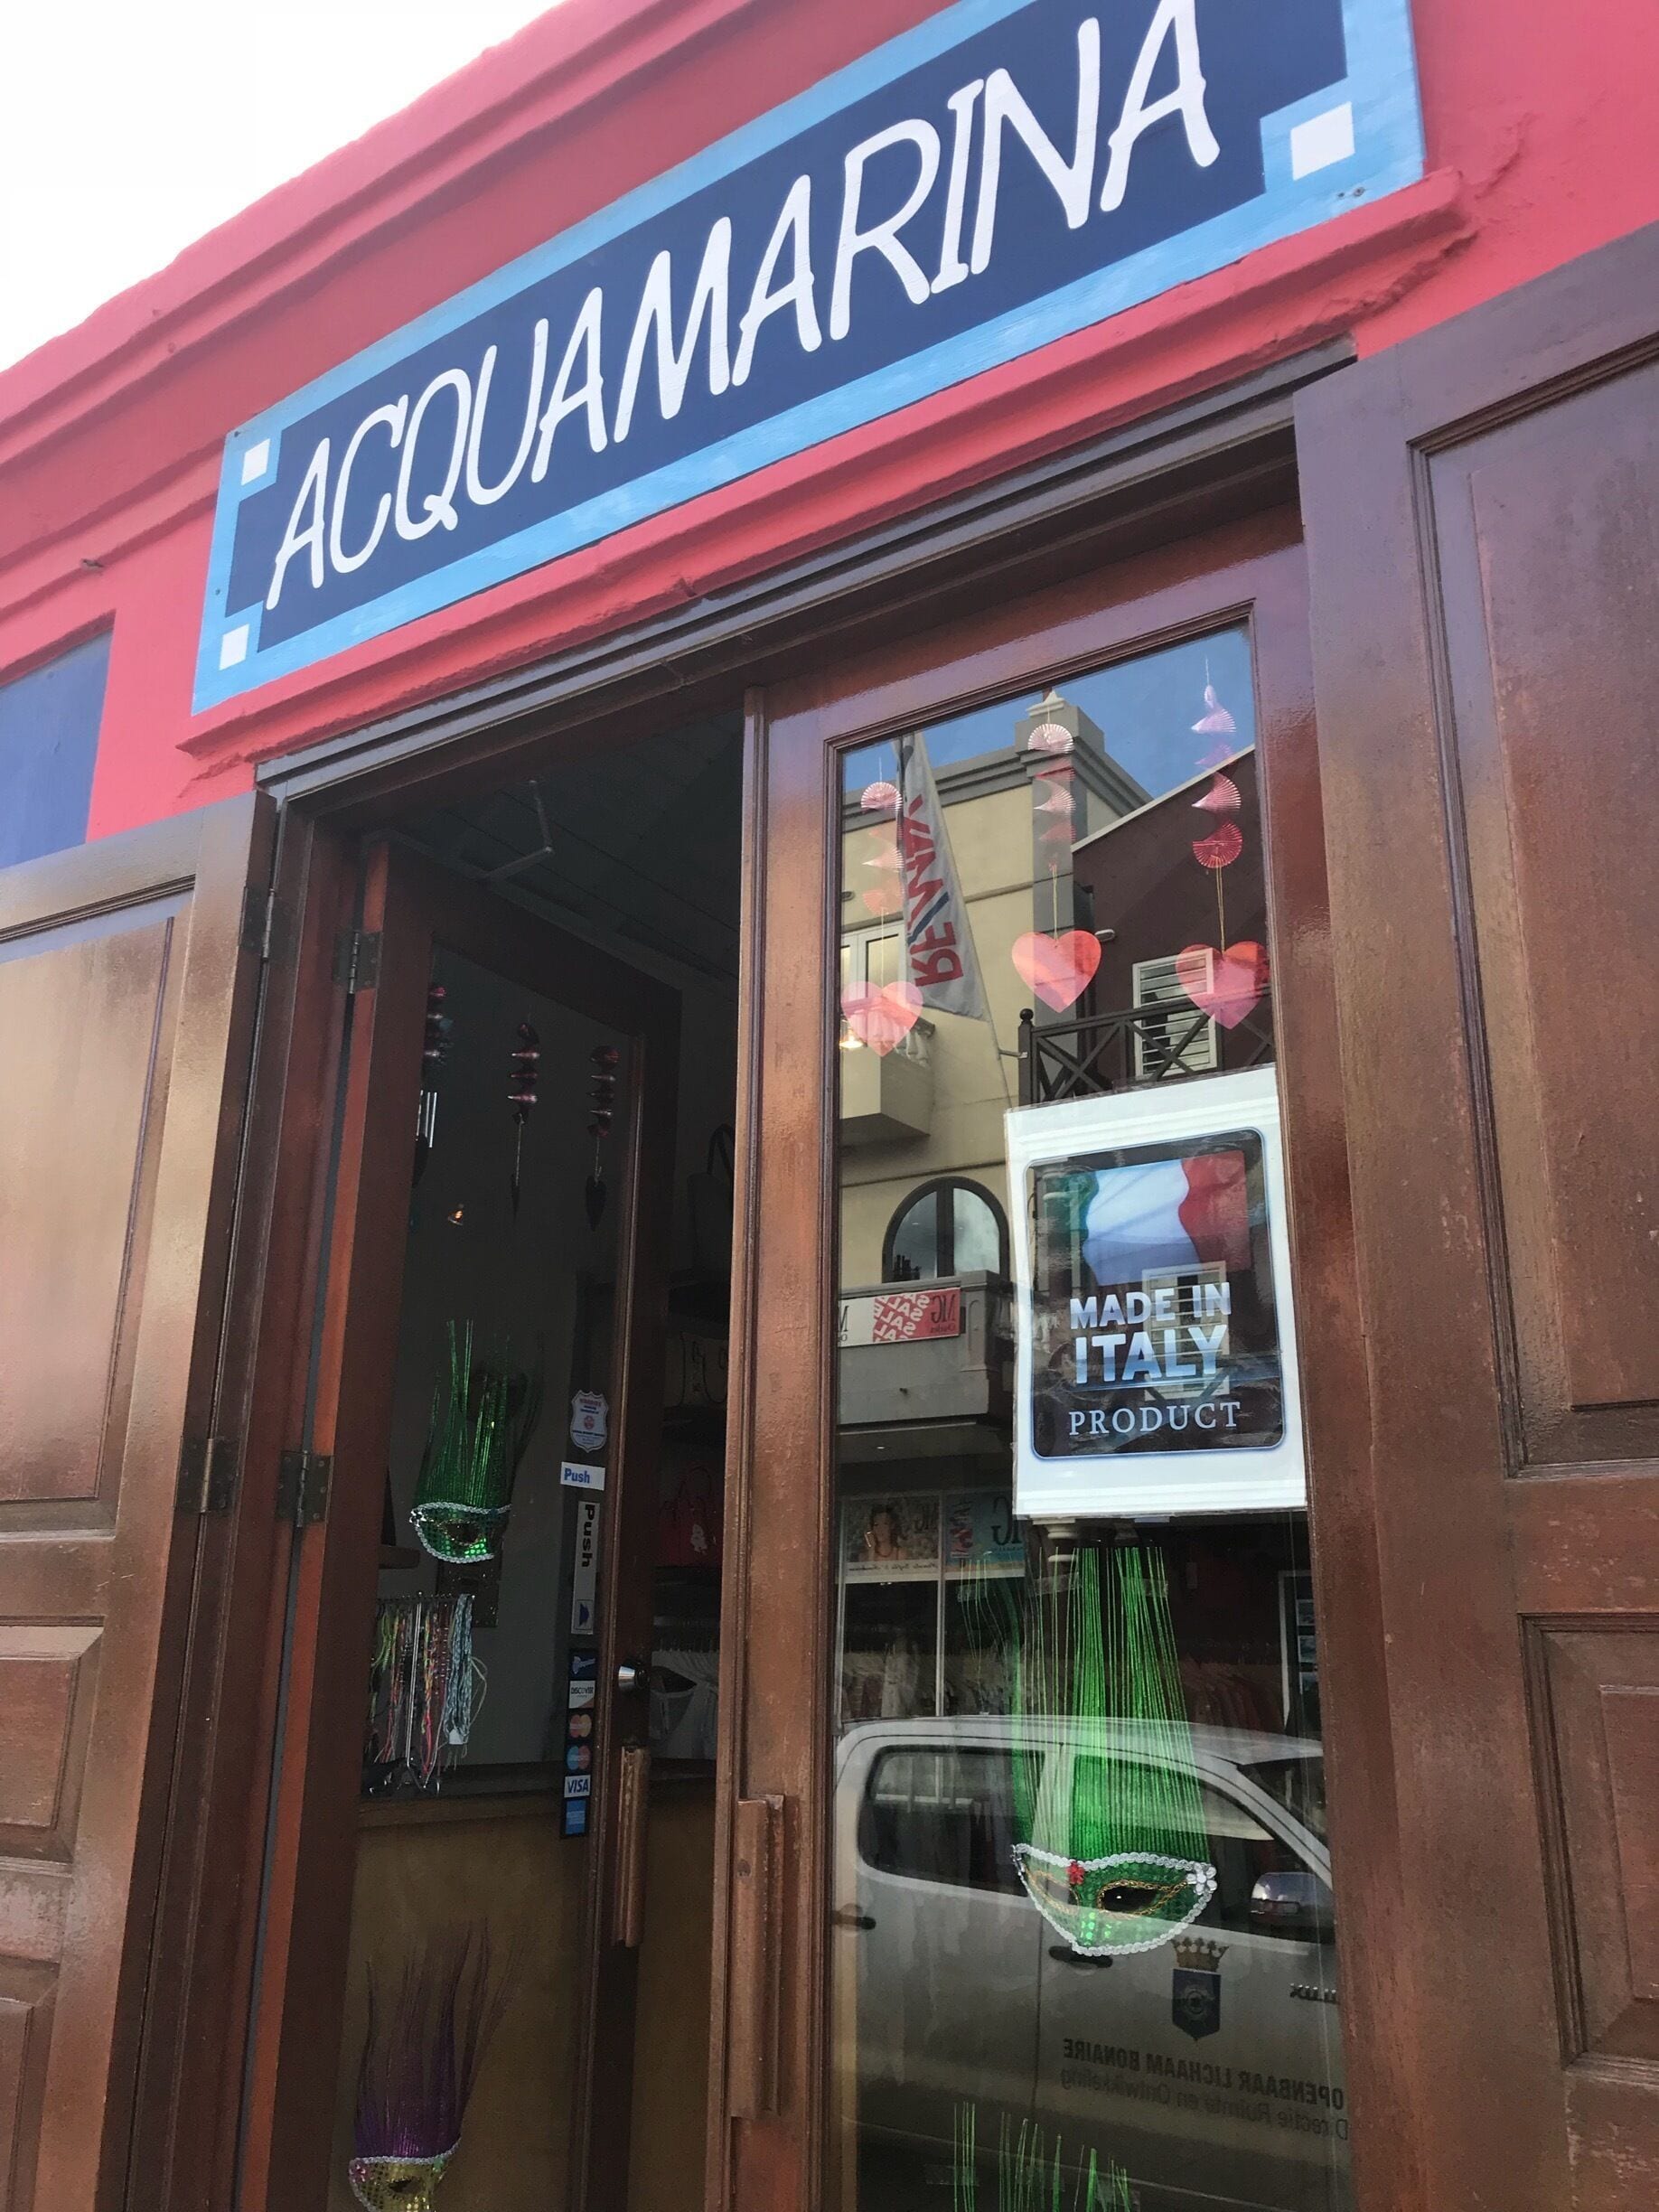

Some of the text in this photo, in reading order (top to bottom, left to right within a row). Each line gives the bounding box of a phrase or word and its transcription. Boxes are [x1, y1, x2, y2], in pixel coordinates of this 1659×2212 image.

[265, 0, 1221, 610] ACQUAMARINA
[1070, 1281, 1232, 1329] MADE IN
[1074, 1325, 1228, 1384] ITALY
[1068, 1401, 1242, 1436] PRODUCT
[564, 1467, 590, 1483] Push
[581, 1504, 595, 1568] Push
[567, 1778, 589, 1794] VISA
